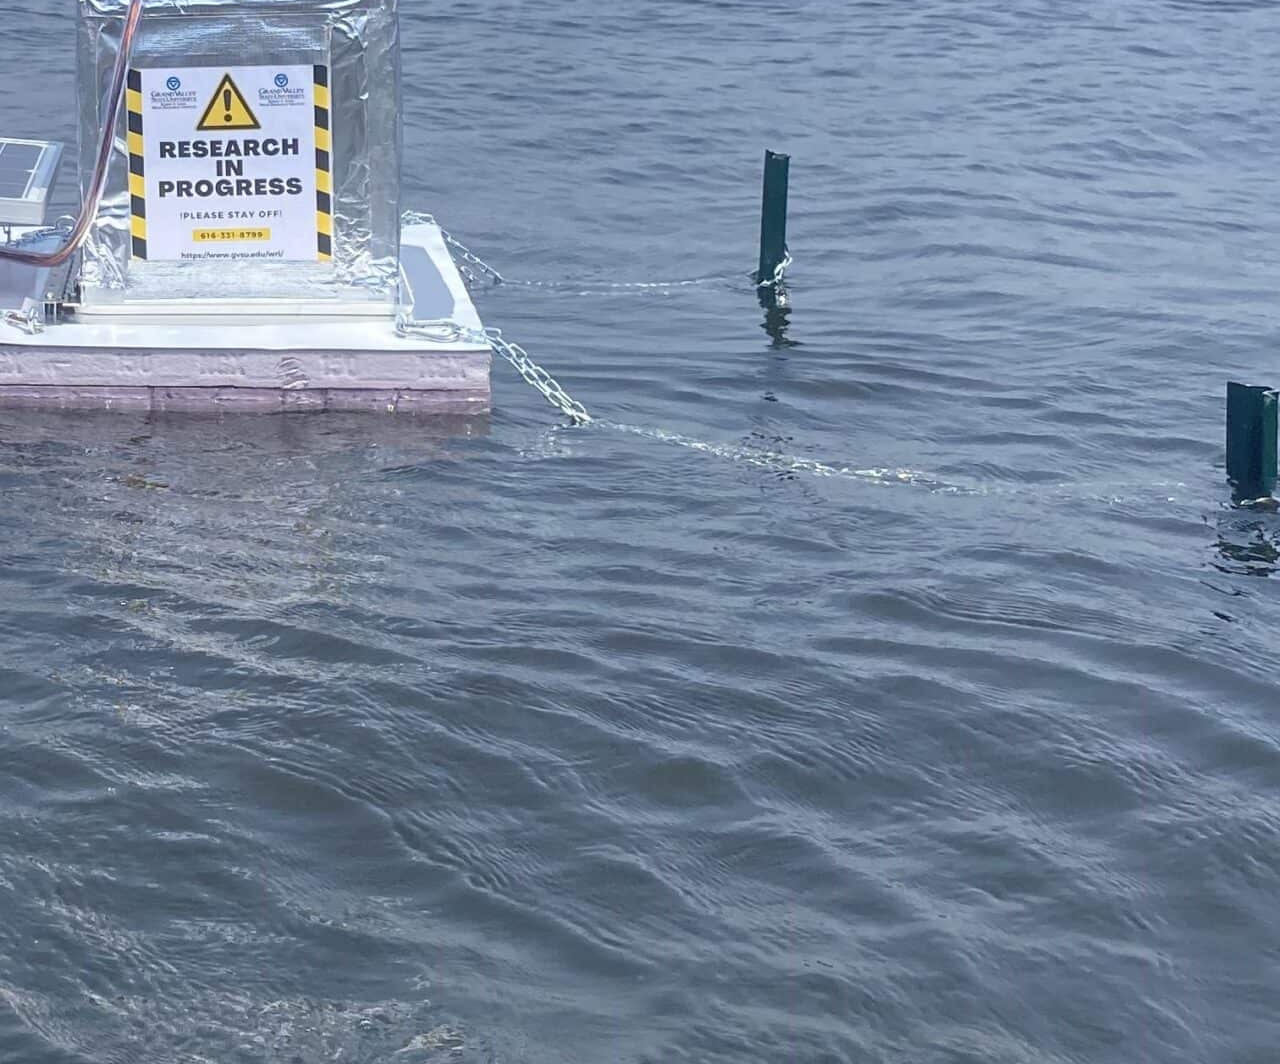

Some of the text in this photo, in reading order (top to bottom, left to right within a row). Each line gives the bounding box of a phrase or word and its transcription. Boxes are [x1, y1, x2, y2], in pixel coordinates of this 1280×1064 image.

[159, 138, 299, 158] RESEARCH
[216, 159, 243, 176] IN
[158, 177, 303, 197] PROGRESS
[227, 210, 255, 219] STAY
[258, 209, 282, 218] OFF!
